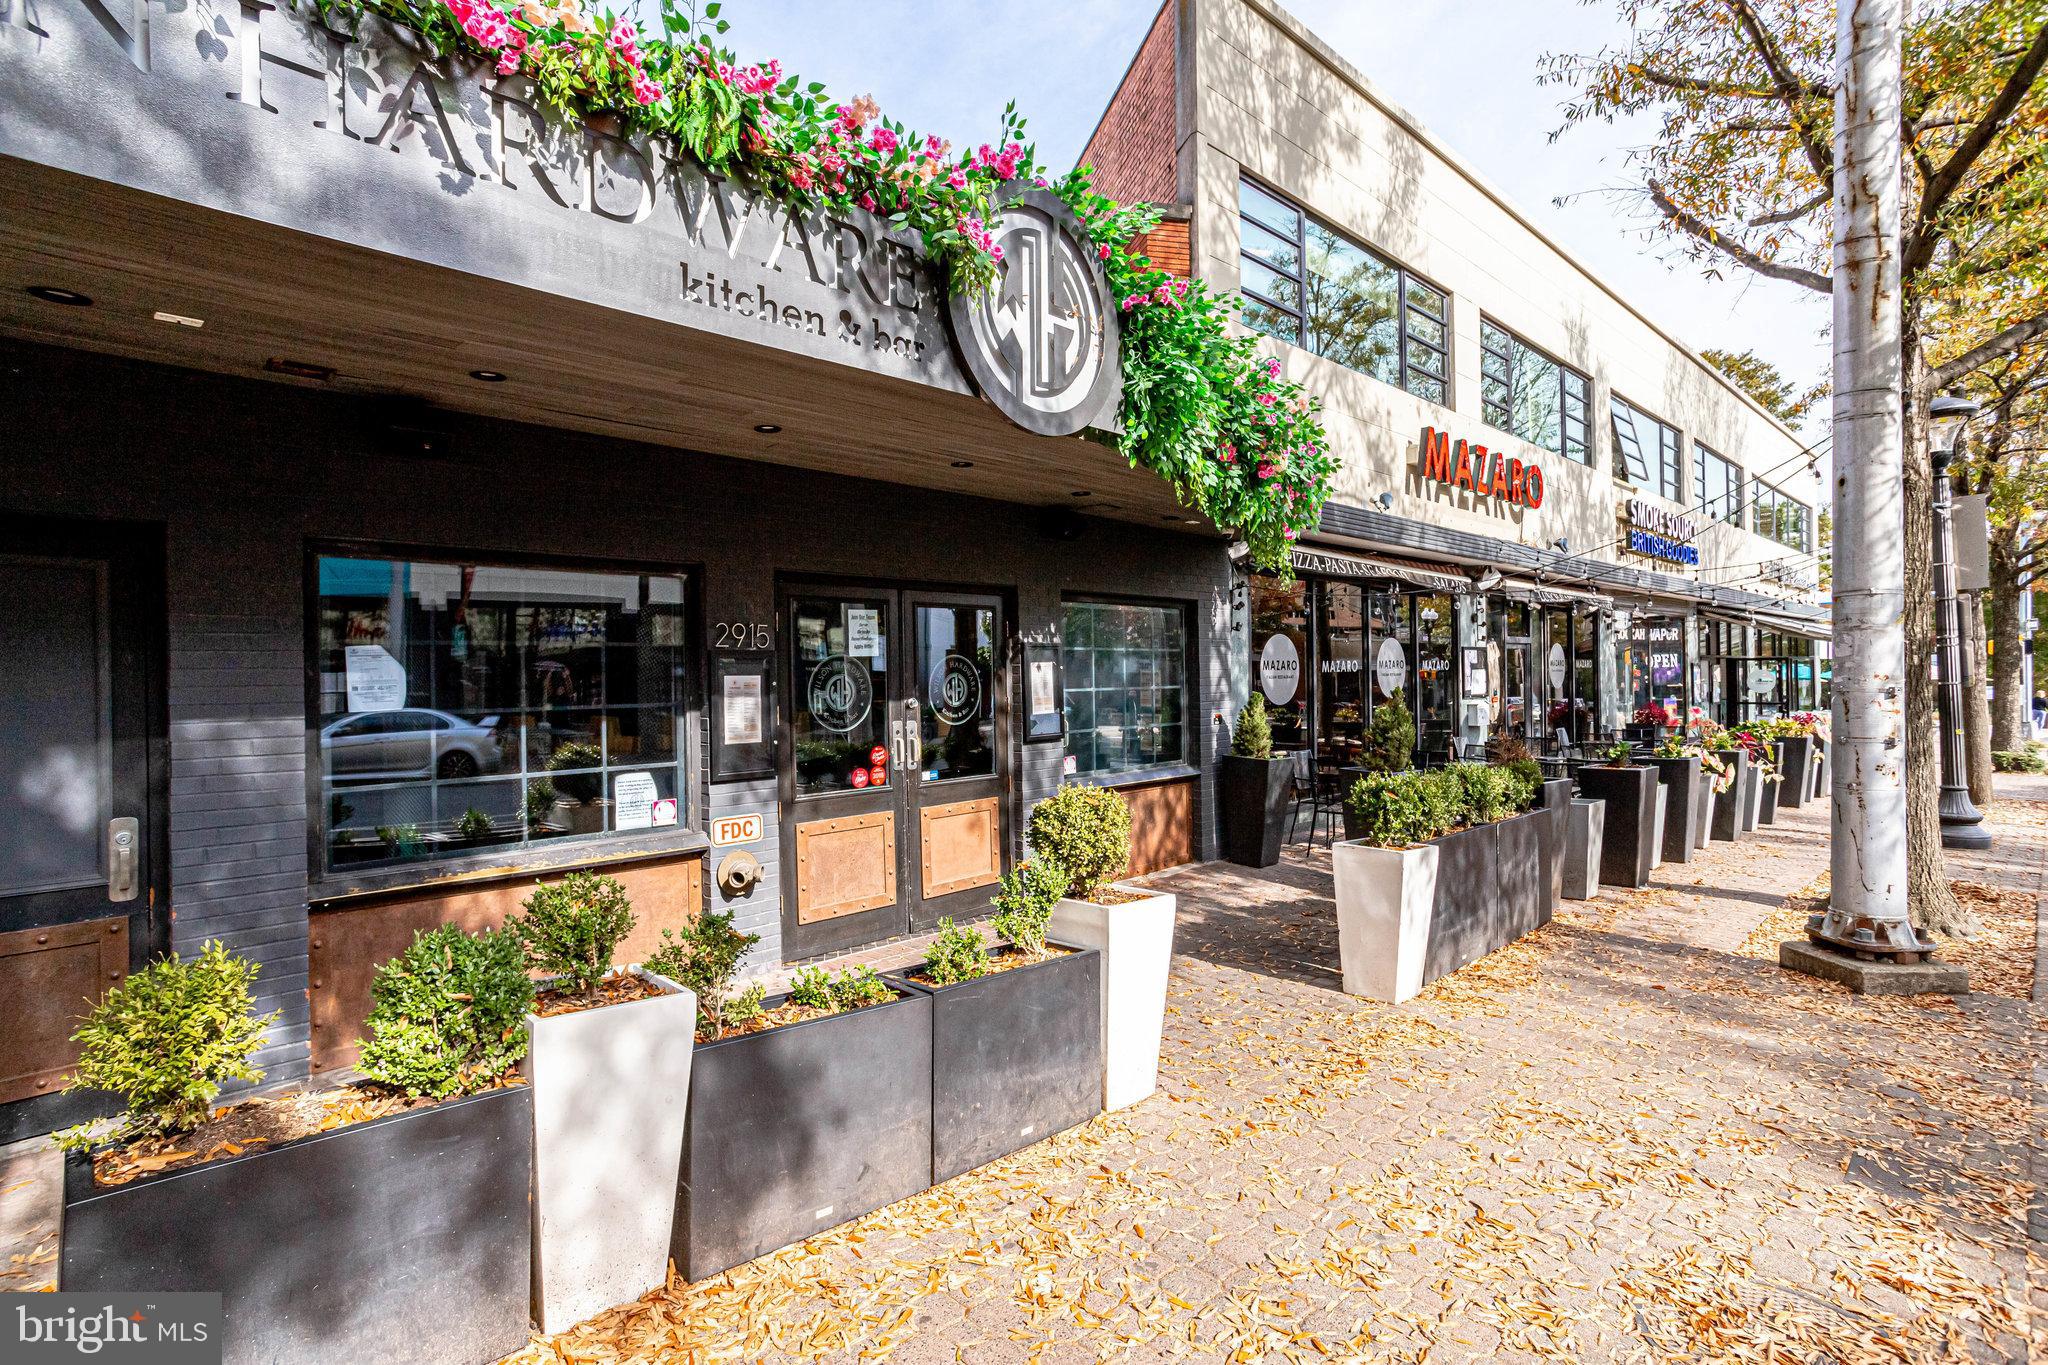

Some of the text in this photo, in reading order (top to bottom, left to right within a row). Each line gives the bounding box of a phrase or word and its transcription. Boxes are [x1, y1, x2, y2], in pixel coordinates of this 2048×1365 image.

[226, 0, 920, 313] HARDWARE
[680, 262, 925, 362] kitchen & bar
[1419, 426, 1543, 509] MAZARO
[1630, 499, 1664, 534] SMOKE
[715, 622, 770, 649] 2915
[1262, 660, 1298, 671] MAZARO
[1321, 660, 1358, 673] MAZARO
[1378, 659, 1405, 670] MAZARO
[1421, 660, 1450, 671] MAZARO
[1645, 653, 1678, 668] OPEN
[721, 820, 754, 841] FDC
